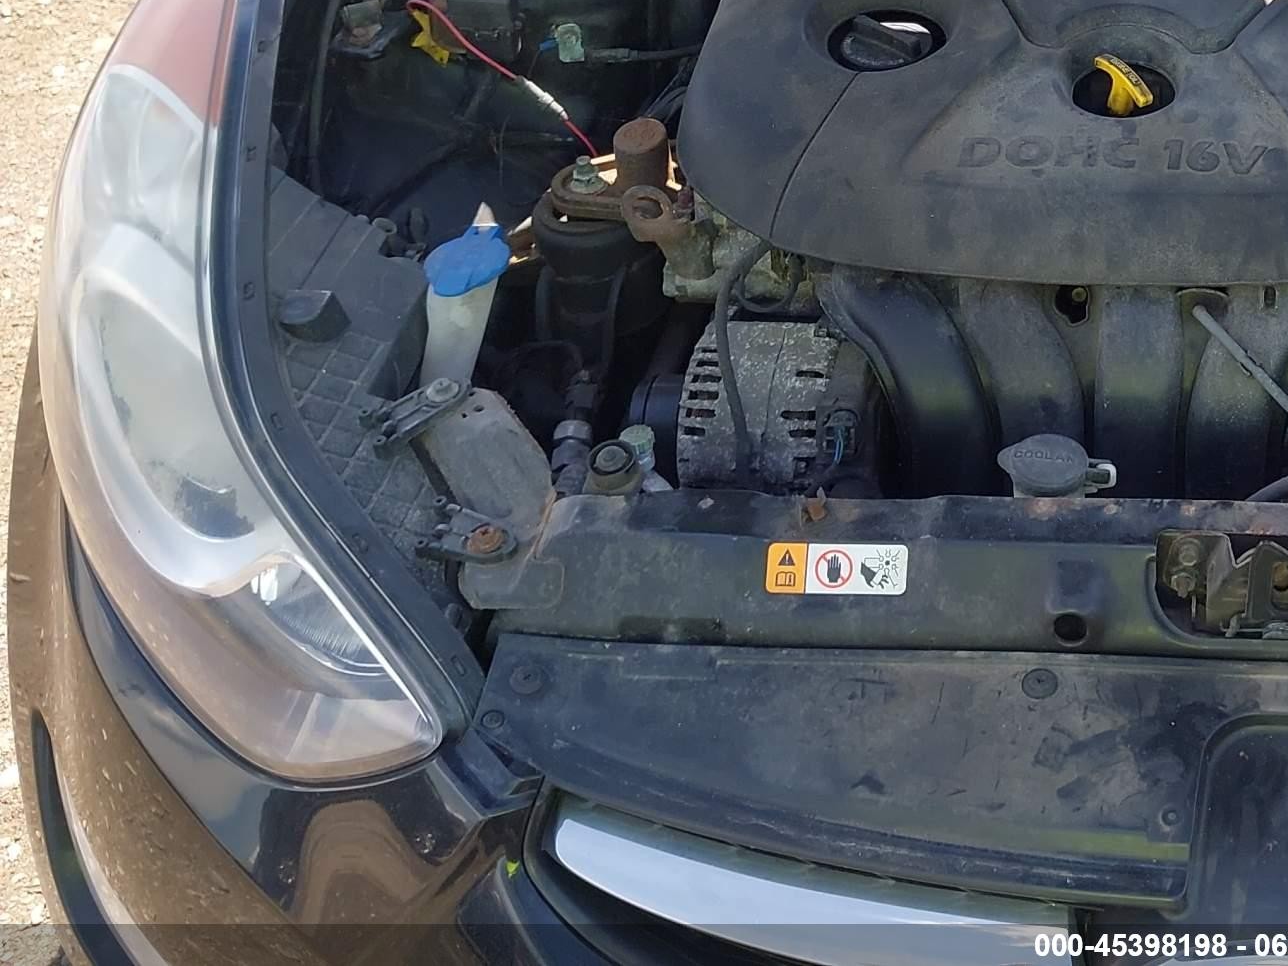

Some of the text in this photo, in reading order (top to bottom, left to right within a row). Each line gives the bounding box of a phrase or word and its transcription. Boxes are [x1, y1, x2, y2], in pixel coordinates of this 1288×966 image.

[956, 136, 1269, 175] DOHC 16V
[1014, 450, 1077, 465] COOLAN
